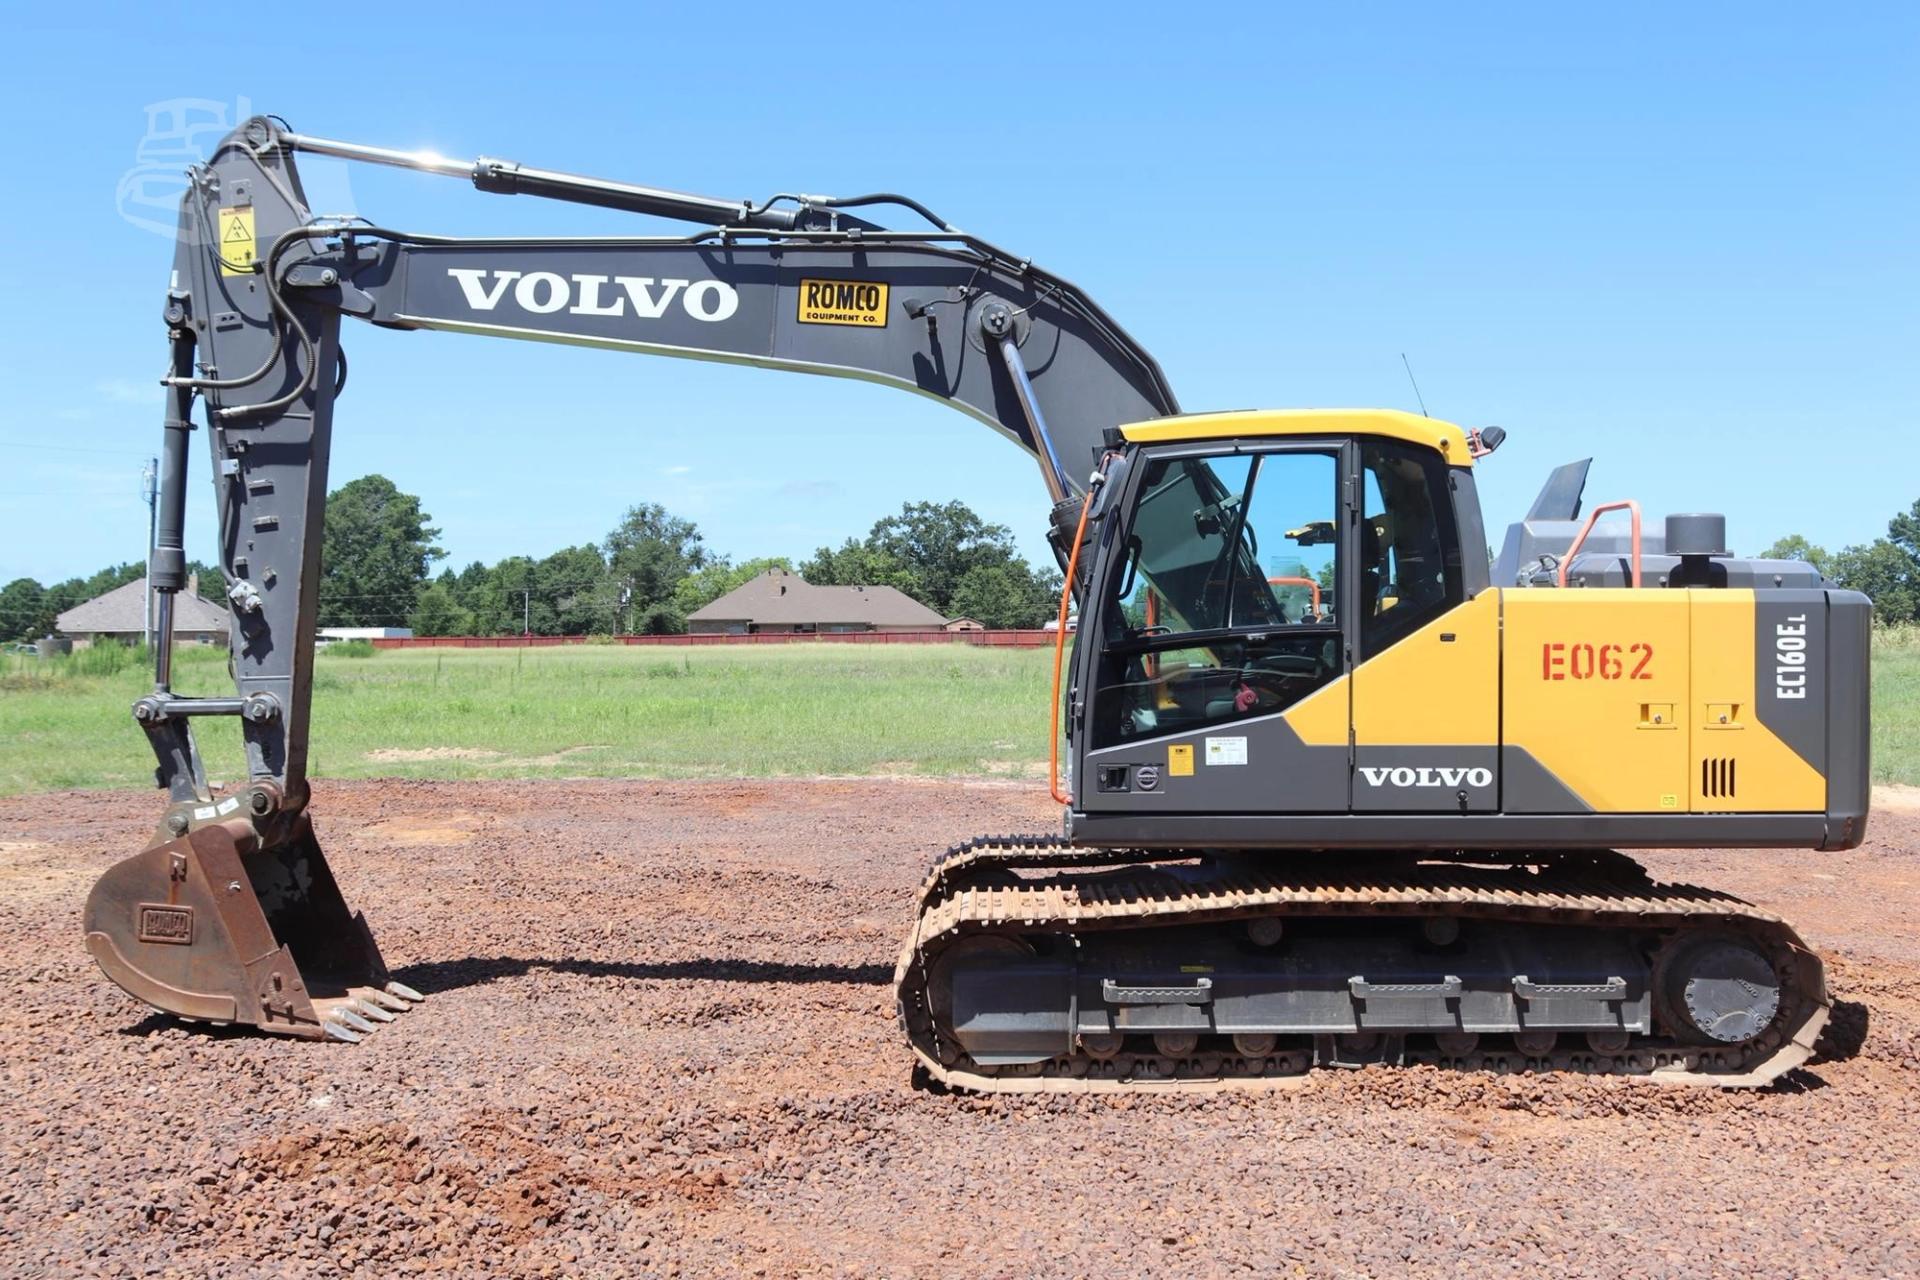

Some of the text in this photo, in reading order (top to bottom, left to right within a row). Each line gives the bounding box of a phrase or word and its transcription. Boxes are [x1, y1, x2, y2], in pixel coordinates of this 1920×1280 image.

[448, 268, 739, 322] VOLVO
[807, 282, 880, 312] ROMCO
[806, 312, 878, 323] EQUIPMENT CO.
[1543, 643, 1653, 680] E062
[1358, 767, 1493, 787] VOLVO
